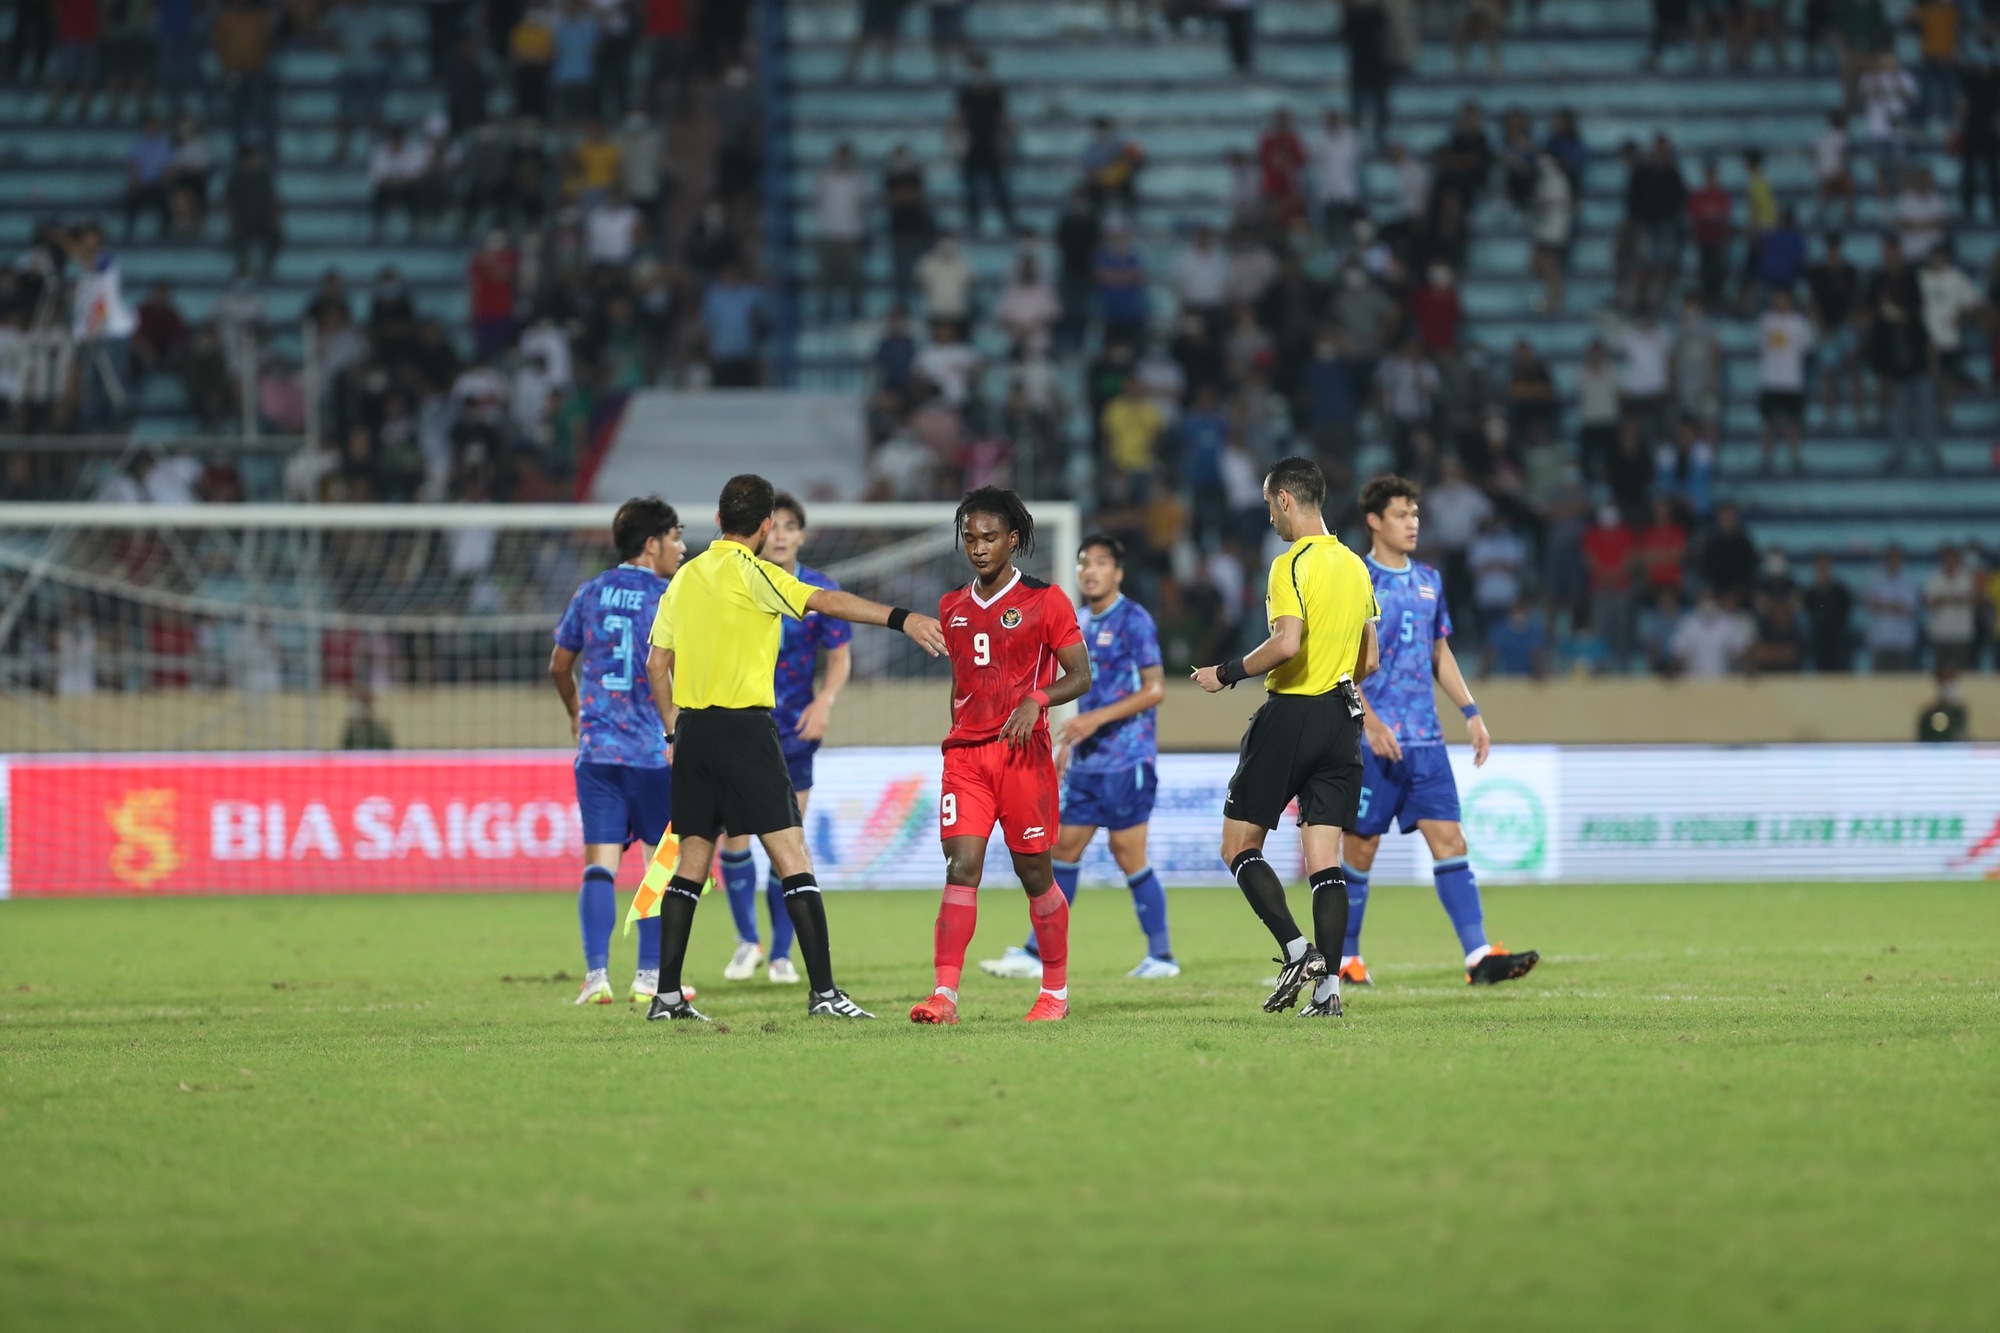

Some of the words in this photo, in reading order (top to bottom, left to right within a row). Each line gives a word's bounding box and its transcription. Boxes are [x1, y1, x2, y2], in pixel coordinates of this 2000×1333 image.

[600, 586, 645, 611] MATEE
[1401, 611, 1414, 642] 5
[602, 615, 633, 691] 3
[973, 632, 991, 666] 9
[942, 792, 957, 827] 9
[211, 800, 342, 860] BIA
